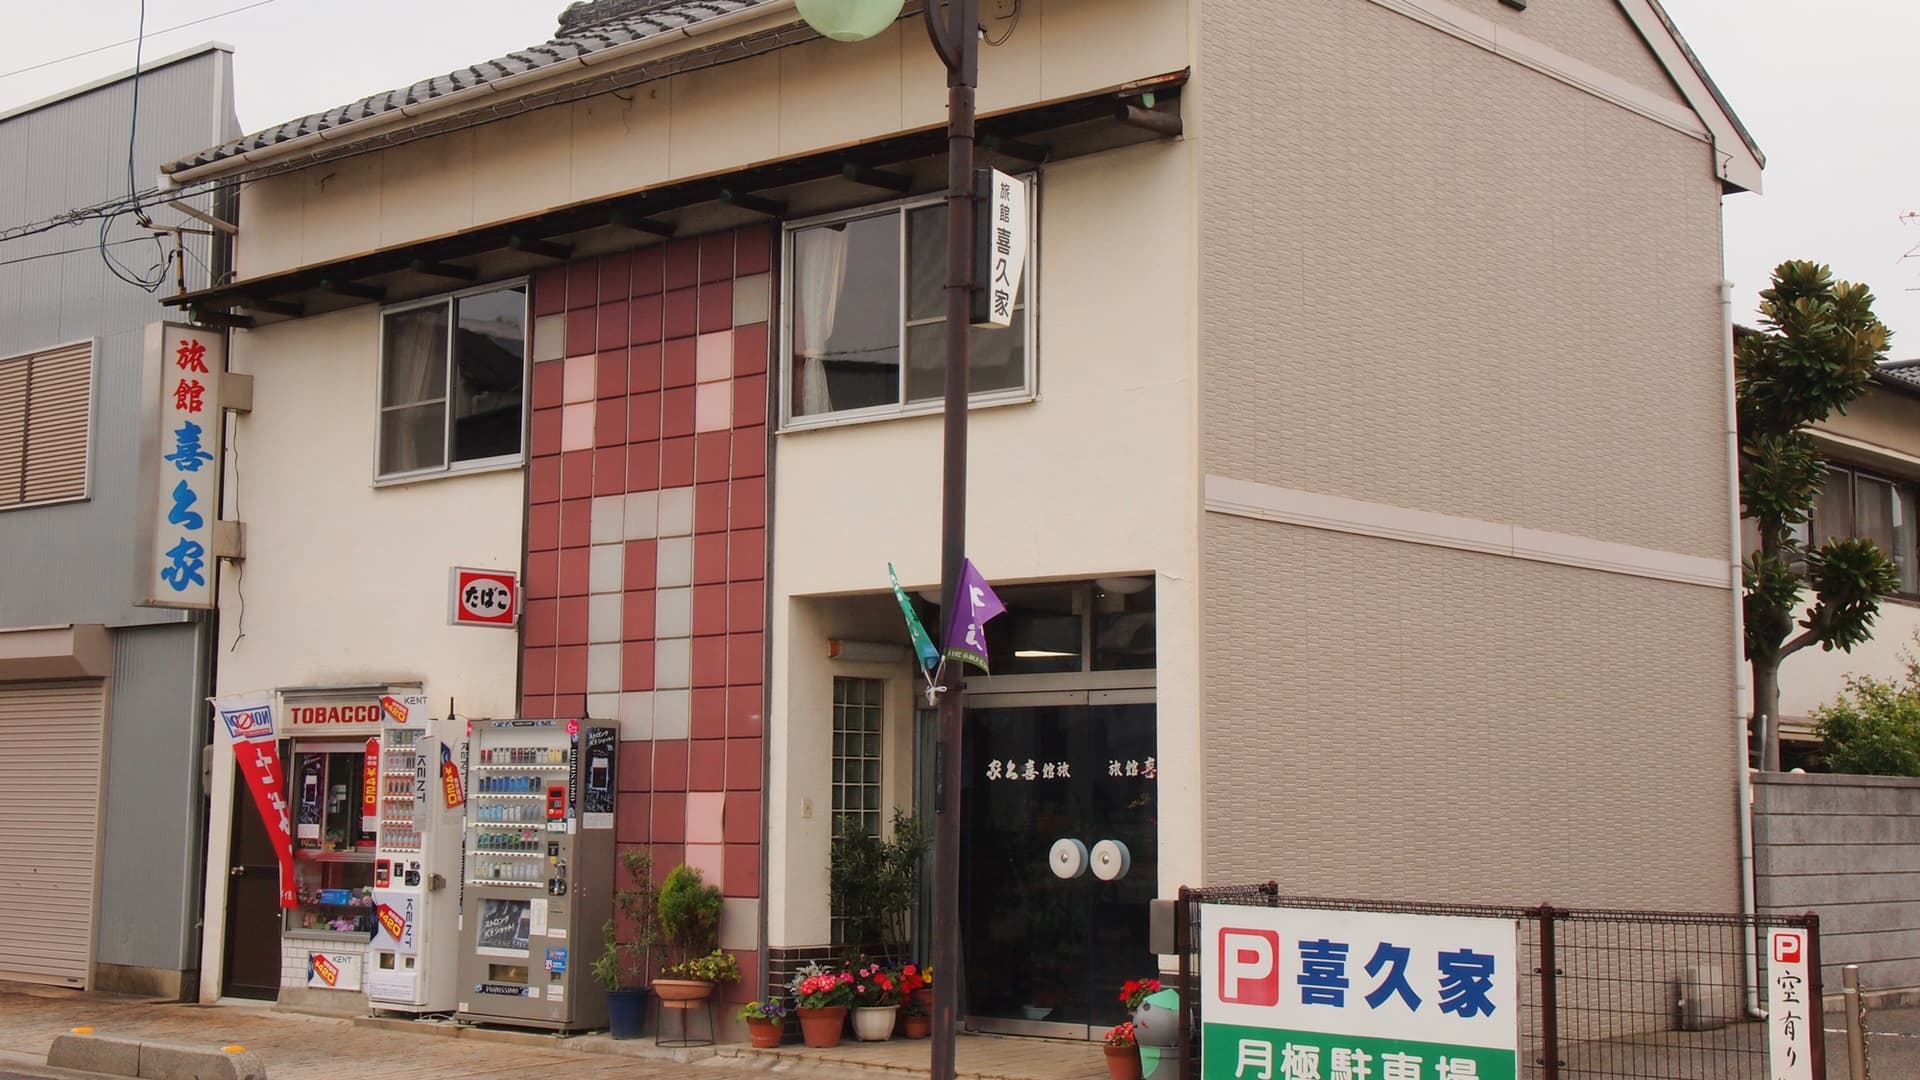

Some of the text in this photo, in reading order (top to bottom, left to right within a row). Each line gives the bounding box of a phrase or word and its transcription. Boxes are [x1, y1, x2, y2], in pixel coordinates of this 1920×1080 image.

[465, 586, 508, 610] たばこ
[291, 704, 380, 725] TOBACCO
[404, 696, 428, 705] KENT
[416, 755, 426, 803] KENT
[405, 898, 414, 949] KENT
[332, 955, 353, 964] KENT
[1296, 938, 1497, 1018] 喜久家
[1777, 969, 1802, 1068] 空有り
